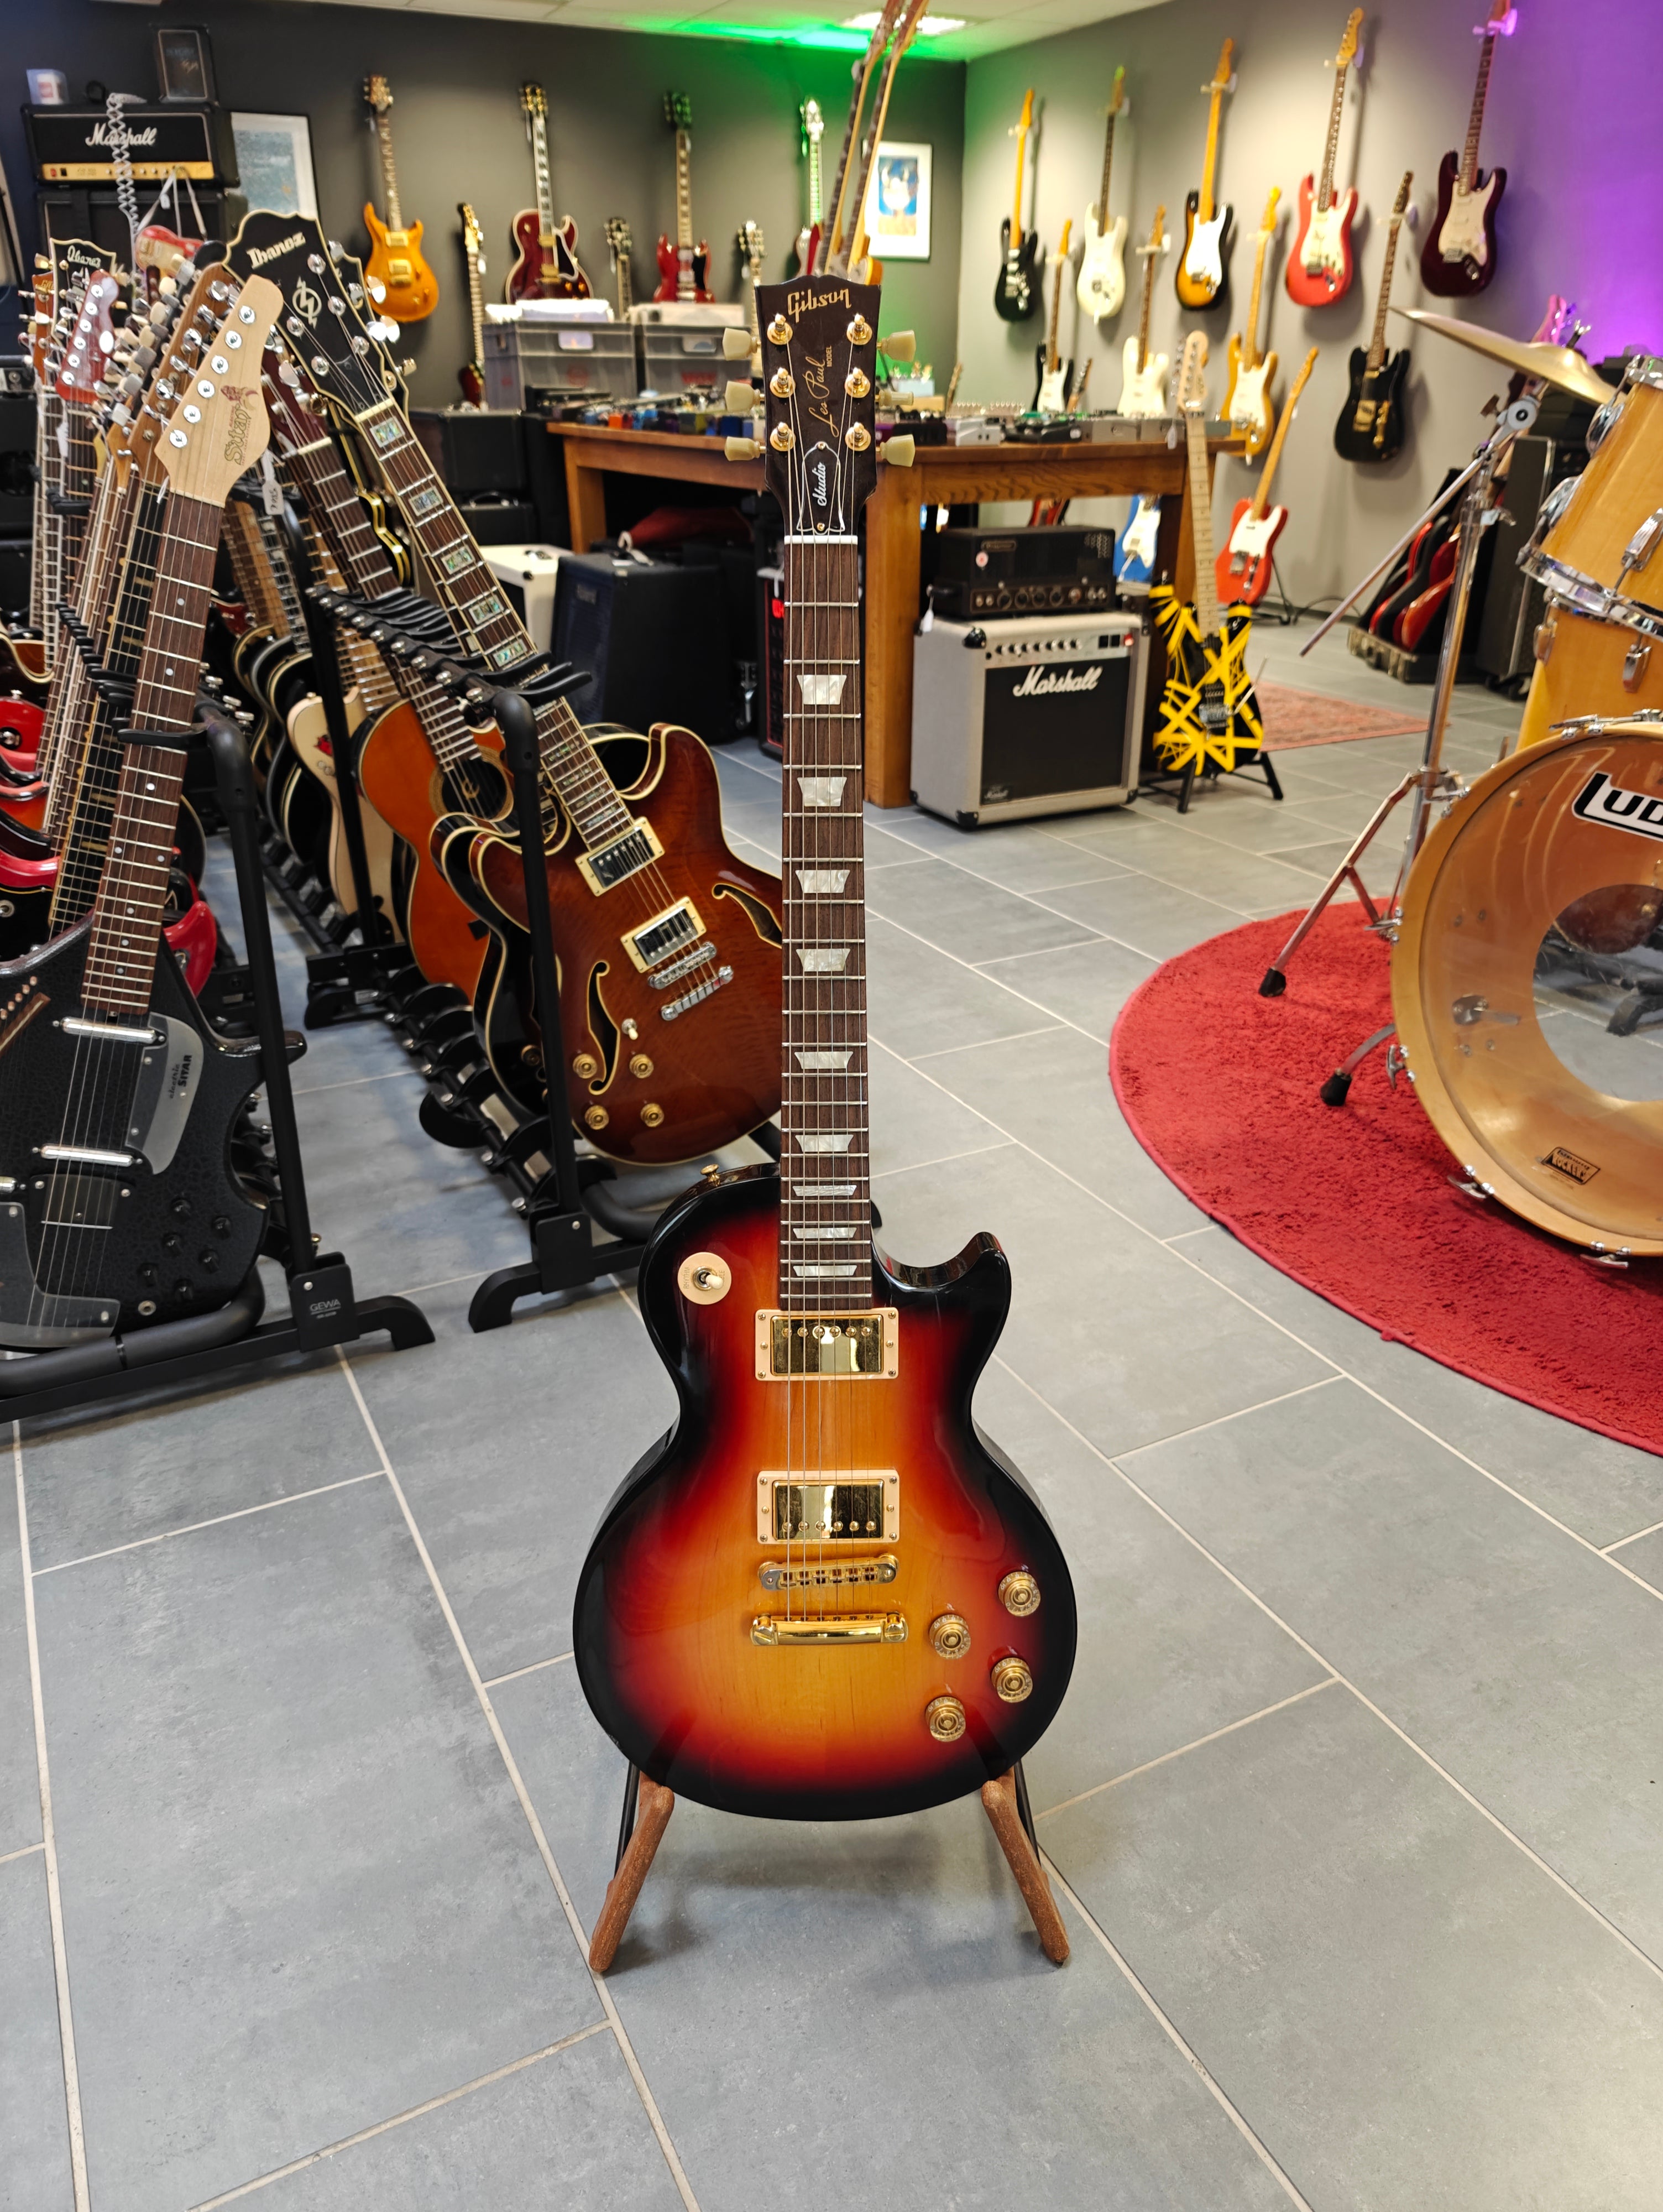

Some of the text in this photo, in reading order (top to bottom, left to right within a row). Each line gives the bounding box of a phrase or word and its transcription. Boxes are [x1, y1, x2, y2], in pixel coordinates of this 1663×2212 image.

[67, 245, 101, 268] Ibanez
[246, 231, 306, 270] Ibanez
[787, 289, 851, 323] Gibson
[802, 356, 839, 437] Les Paul
[224, 403, 252, 465] Sitar
[812, 462, 827, 506] Studio
[1012, 665, 1103, 697] Marshall
[177, 1055, 192, 1087] SITAR
[310, 1298, 341, 1311] GEWA
